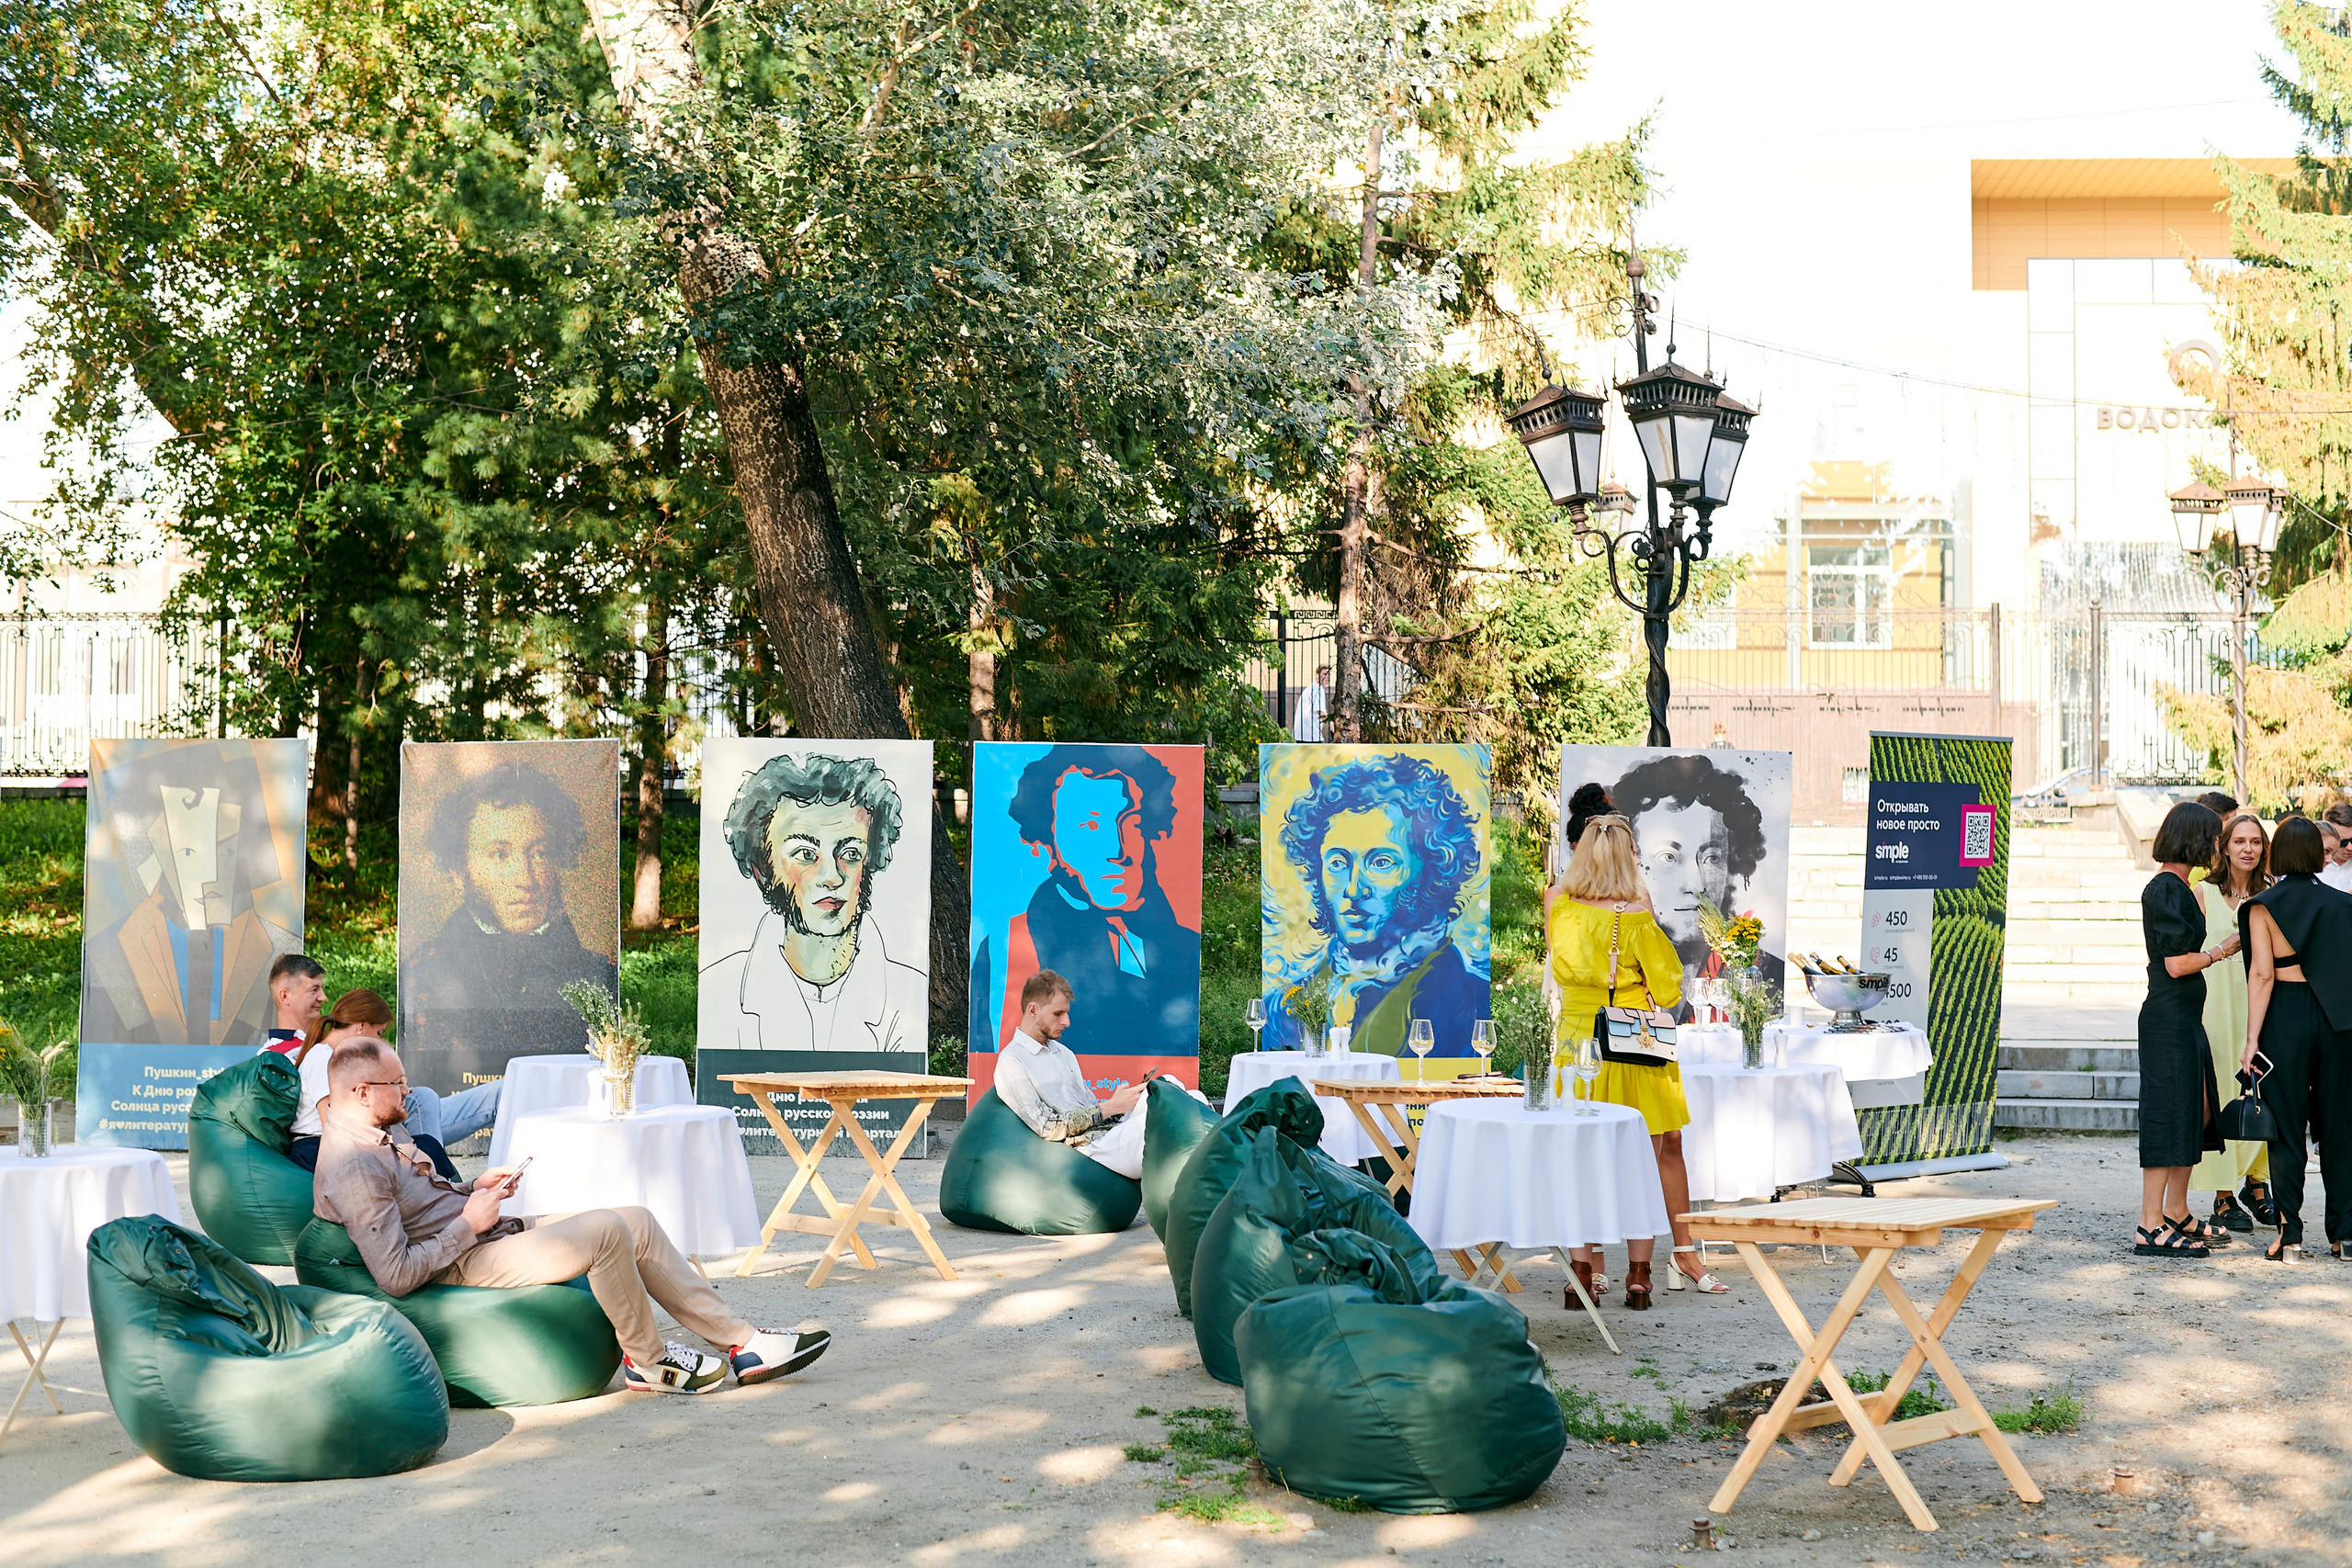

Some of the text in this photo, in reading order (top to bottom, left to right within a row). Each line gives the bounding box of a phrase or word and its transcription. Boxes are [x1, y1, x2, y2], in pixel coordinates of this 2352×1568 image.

[1877, 799, 1929, 816] Открывать
[1876, 819, 1940, 833] новое просто
[1875, 841, 1909, 863] simple
[1885, 910, 1908, 926] 450
[1883, 947, 1898, 962] 45
[132, 1085, 141, 1096] К
[143, 1085, 174, 1098] Дню
[111, 1100, 160, 1112] Солнца
